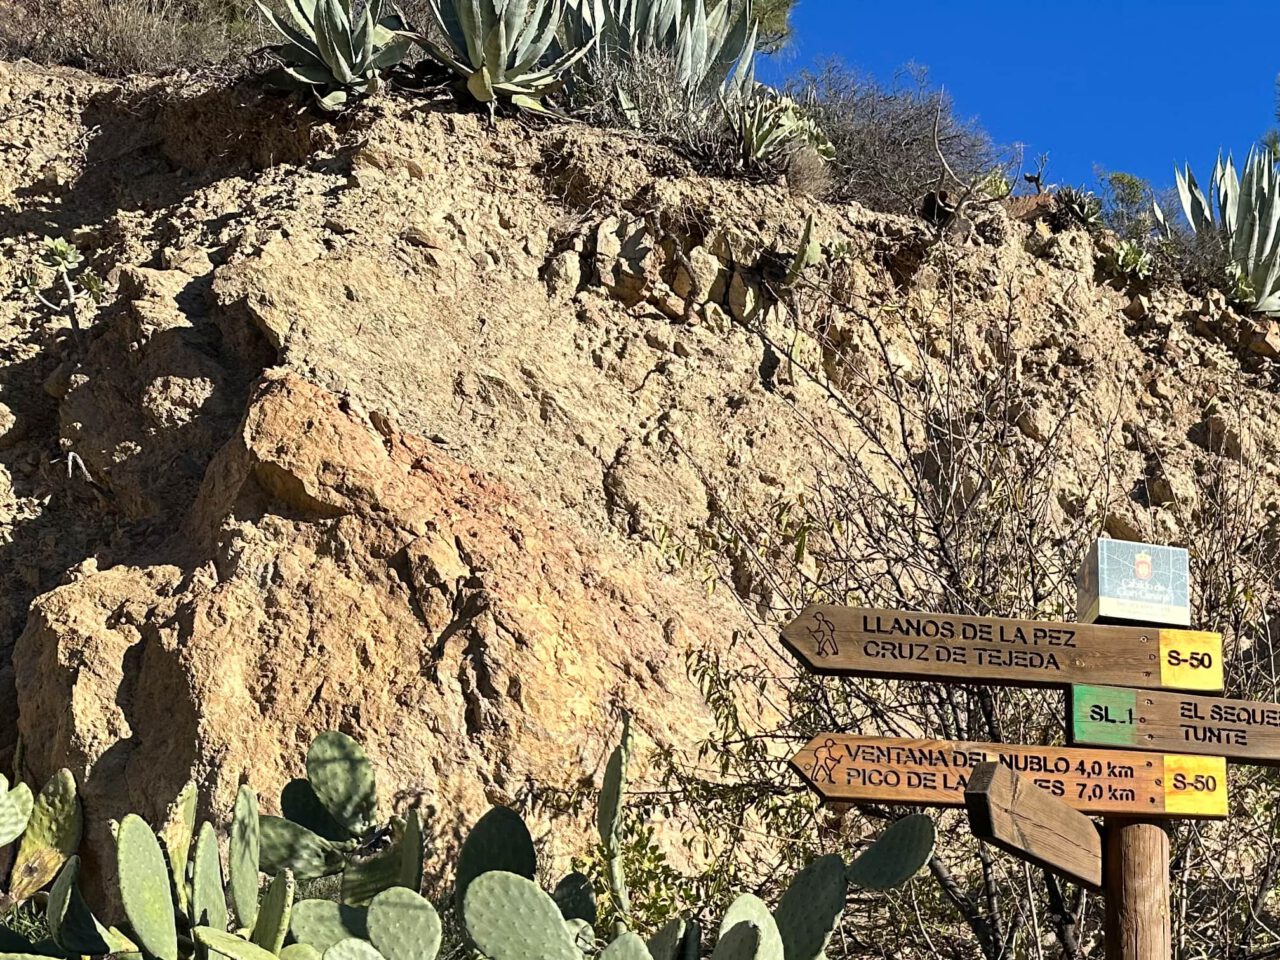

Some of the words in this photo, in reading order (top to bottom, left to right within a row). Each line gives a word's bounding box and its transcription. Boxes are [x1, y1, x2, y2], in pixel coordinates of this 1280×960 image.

[863, 615, 955, 639] LLANOS
[961, 622, 993, 643] DE
[999, 625, 1028, 645] LA
[1033, 628, 1077, 648] PEZ
[863, 640, 930, 662] CRUZ
[935, 645, 967, 664] DE
[973, 647, 1061, 670] TEJEDA
[1167, 649, 1213, 669] S-50
[1180, 701, 1205, 720] EL
[1179, 724, 1248, 746] TUNTE
[844, 743, 949, 767] VENTANA
[998, 753, 1070, 774] NUBLO
[1074, 759, 1102, 778] 4,0
[1107, 761, 1134, 779] km
[846, 767, 901, 787] PICO
[906, 771, 937, 790] DE
[1075, 783, 1103, 801] 7,0
[1108, 784, 1135, 801] km
[1172, 773, 1217, 792] S-50
